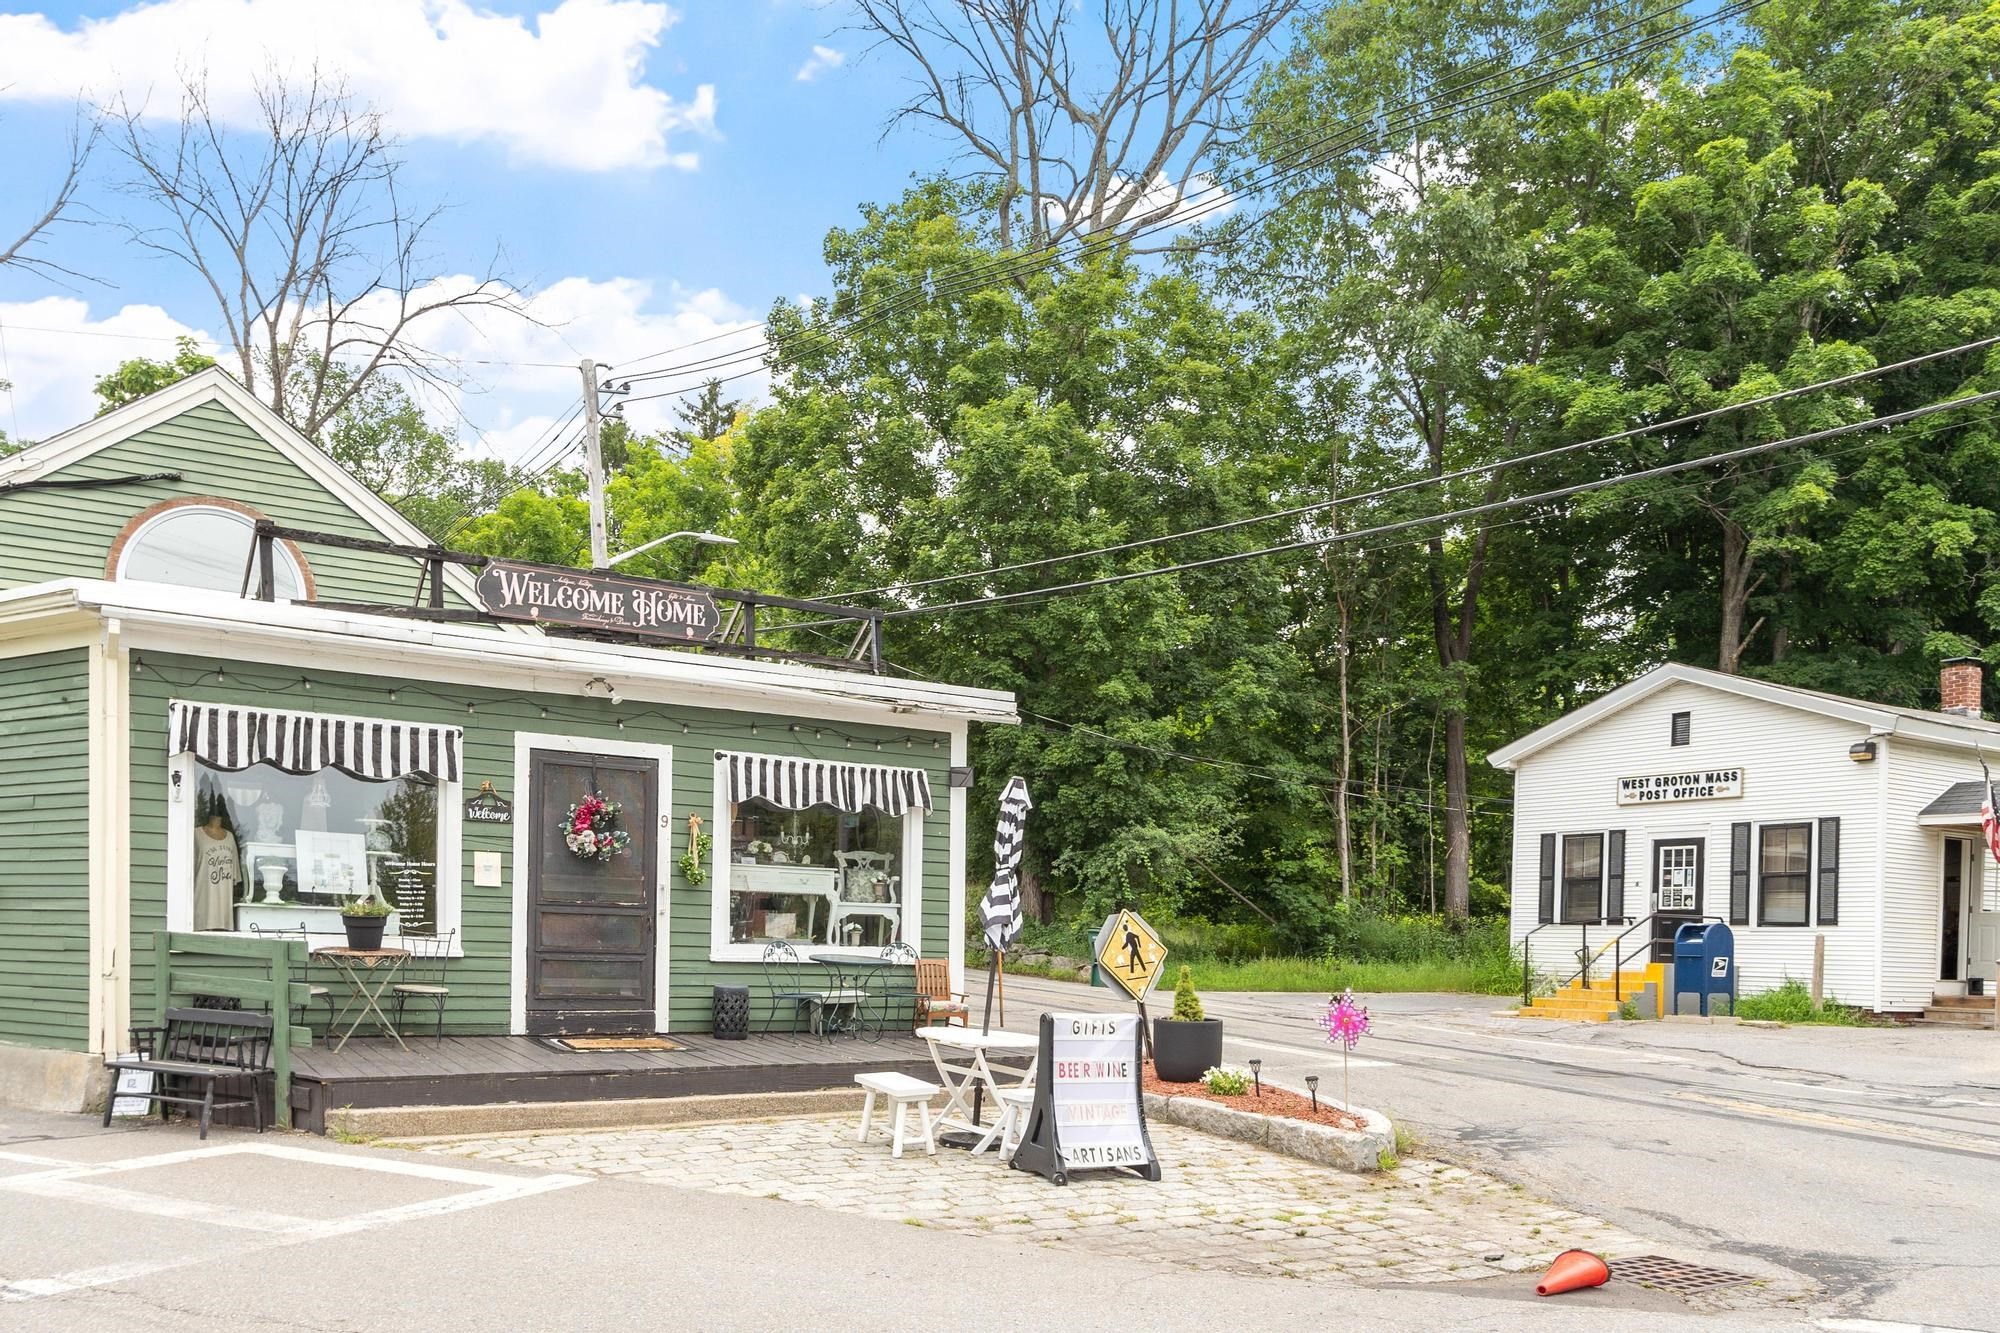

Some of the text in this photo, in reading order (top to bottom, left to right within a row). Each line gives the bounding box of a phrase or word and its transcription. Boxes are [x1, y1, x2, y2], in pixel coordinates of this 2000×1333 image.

[492, 568, 706, 628] WELCOME HOME
[1622, 771, 1738, 790] WEST GROTON MASS
[1639, 786, 1714, 800] POST OFFICE
[468, 806, 511, 821] Welcome
[660, 814, 669, 828] 9
[1058, 1062, 1128, 1078] BEER WINE
[1068, 1103, 1127, 1121] VINTAGE
[1073, 1146, 1142, 1164] ARTISANS
